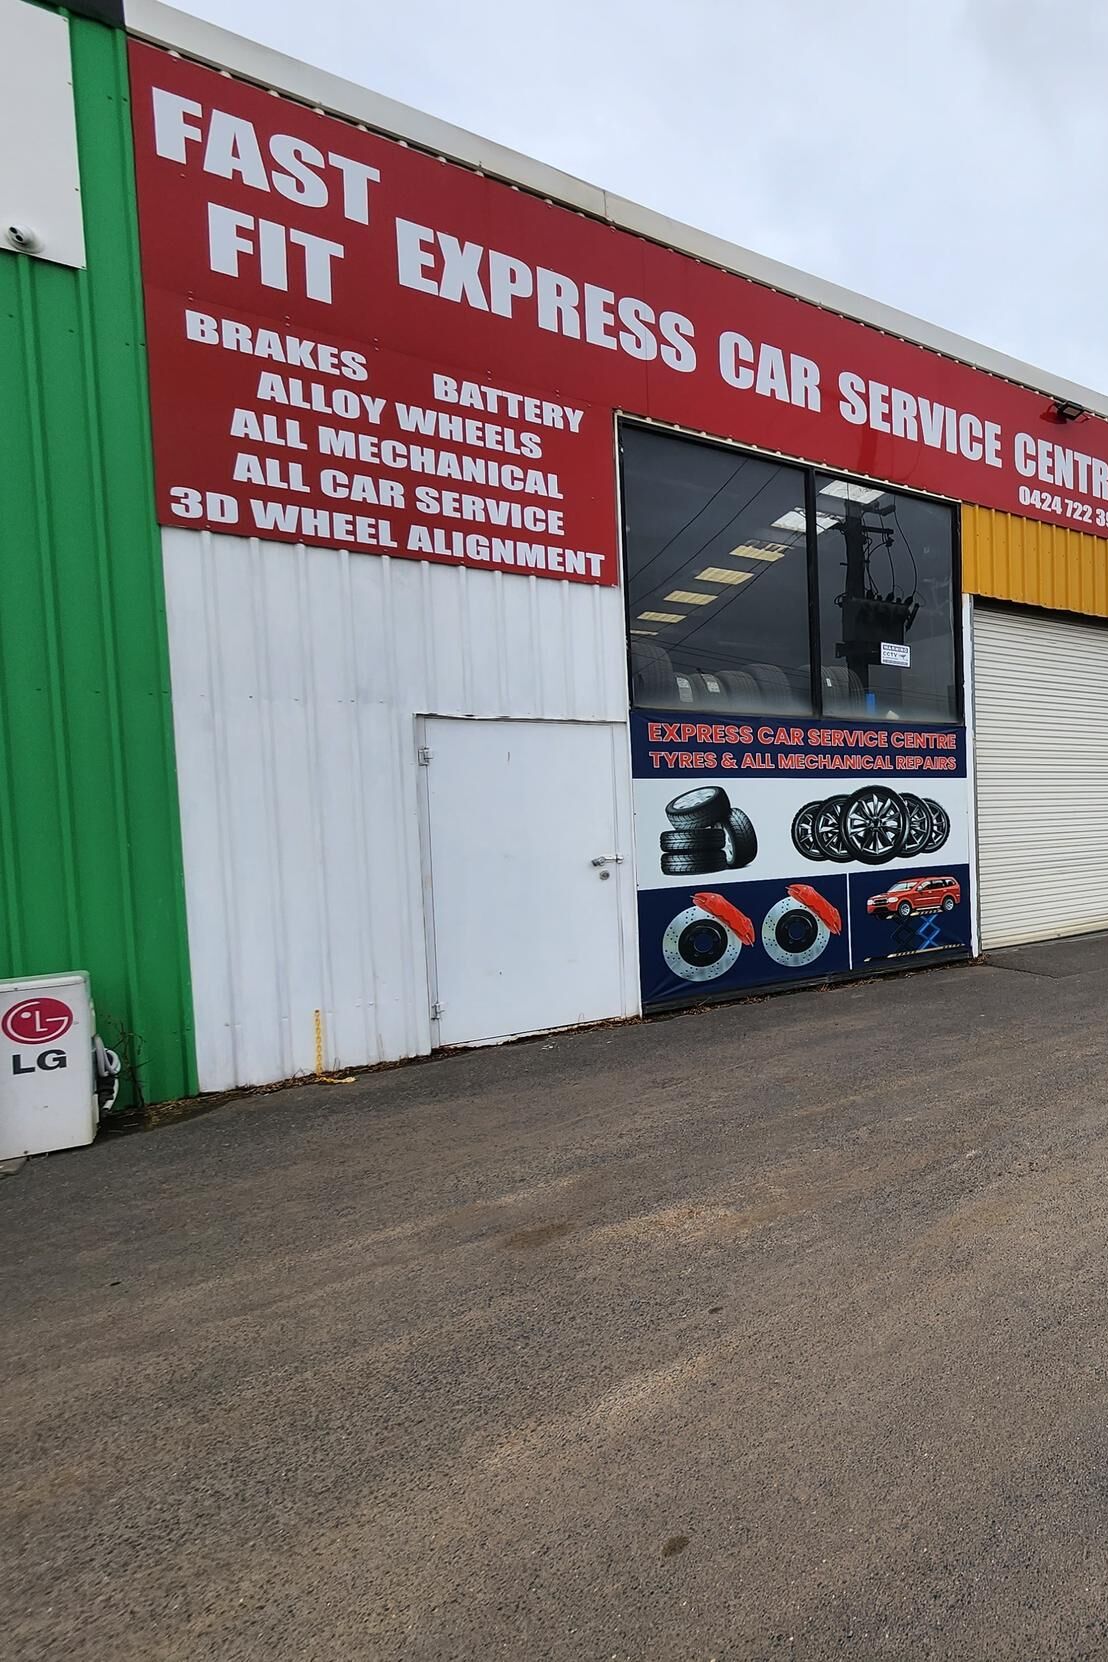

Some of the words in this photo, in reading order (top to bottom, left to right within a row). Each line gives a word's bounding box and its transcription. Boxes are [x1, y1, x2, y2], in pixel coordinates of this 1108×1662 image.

[152, 86, 381, 225] FAST
[207, 201, 345, 304] FIT
[185, 309, 369, 381] BRAKES
[395, 217, 697, 373] EXPRESS
[719, 331, 821, 413] CAR
[839, 371, 1003, 468] SERVICE
[257, 371, 386, 425] ALLOY
[395, 402, 543, 459] WHEELS
[432, 373, 584, 433] BATTERY
[229, 408, 307, 451] ALL
[318, 427, 564, 499] MECHANICAL
[233, 452, 310, 493] ALL
[320, 469, 405, 509] CAR
[415, 485, 565, 536] SERVICE
[170, 486, 239, 524] 3D
[250, 499, 397, 548] WHEEL
[406, 525, 605, 577] ALIGNMENT
[1018, 485, 1062, 515] 0424
[1064, 498, 1093, 524] 722
[648, 722, 753, 745] EXPRESS
[757, 726, 804, 747] CAR
[807, 728, 889, 749] SERVICE
[891, 731, 957, 750] CENTRE
[648, 751, 718, 770] TYRES
[721, 753, 738, 769] &
[741, 752, 775, 770] ALL
[777, 753, 894, 772] MECHANICAL
[895, 755, 957, 771] REPAIRS
[12, 1049, 67, 1075] LG
